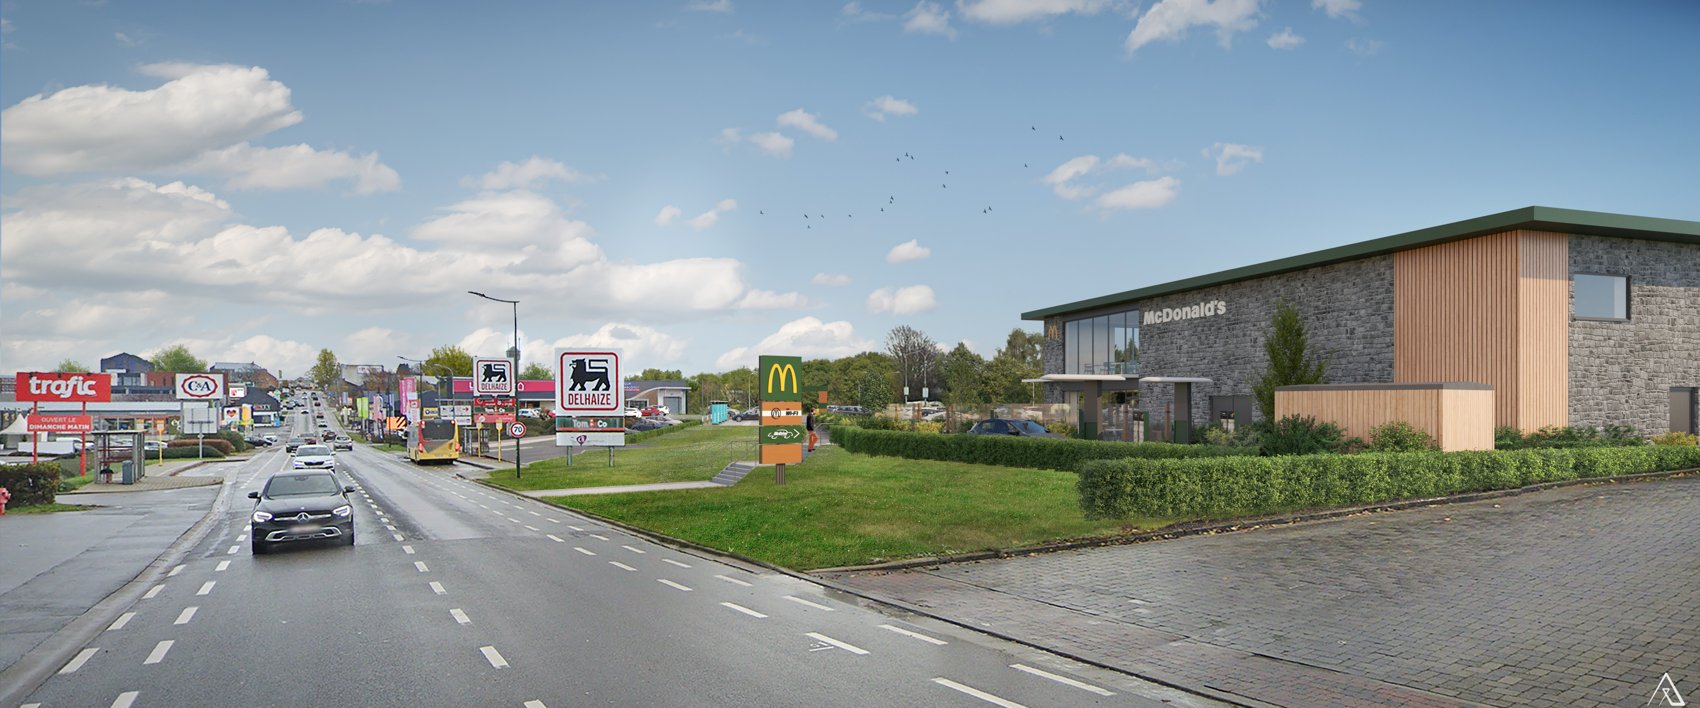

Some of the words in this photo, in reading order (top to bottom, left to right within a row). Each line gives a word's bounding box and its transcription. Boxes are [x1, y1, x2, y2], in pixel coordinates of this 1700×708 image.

[1143, 300, 1227, 326] McDonald's
[29, 375, 97, 399] trafic
[187, 380, 211, 392] C&A
[481, 383, 508, 391] DELHAIZE
[568, 393, 611, 406] DELHAIZE
[572, 419, 588, 428] Tom
[597, 419, 608, 428] Co
